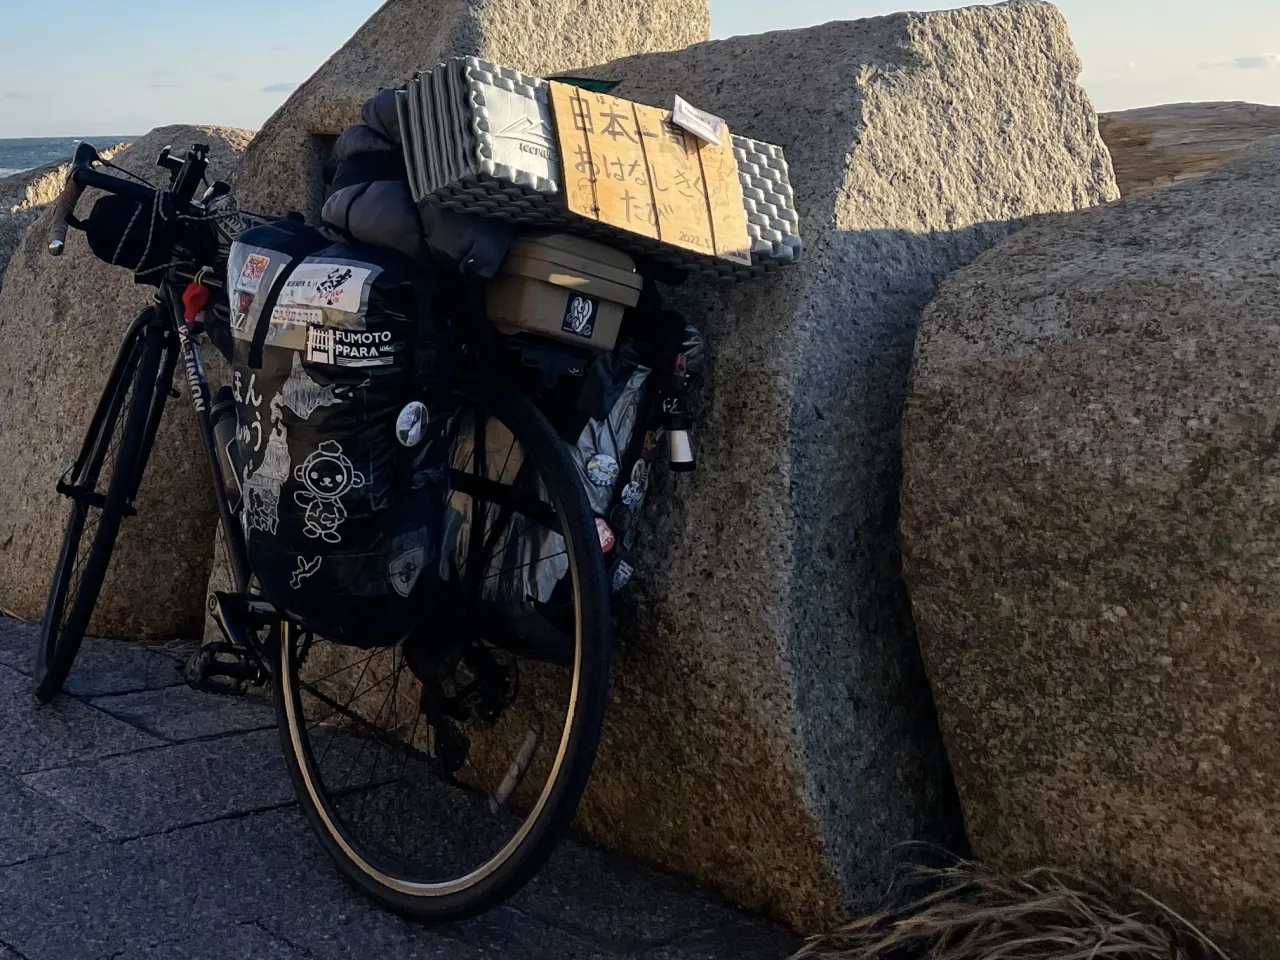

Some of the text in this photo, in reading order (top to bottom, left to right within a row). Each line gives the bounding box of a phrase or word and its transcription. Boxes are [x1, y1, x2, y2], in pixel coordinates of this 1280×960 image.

[620, 189, 674, 226] たび
[335, 330, 392, 344] FUMOTO
[335, 344, 379, 358] PPARA
